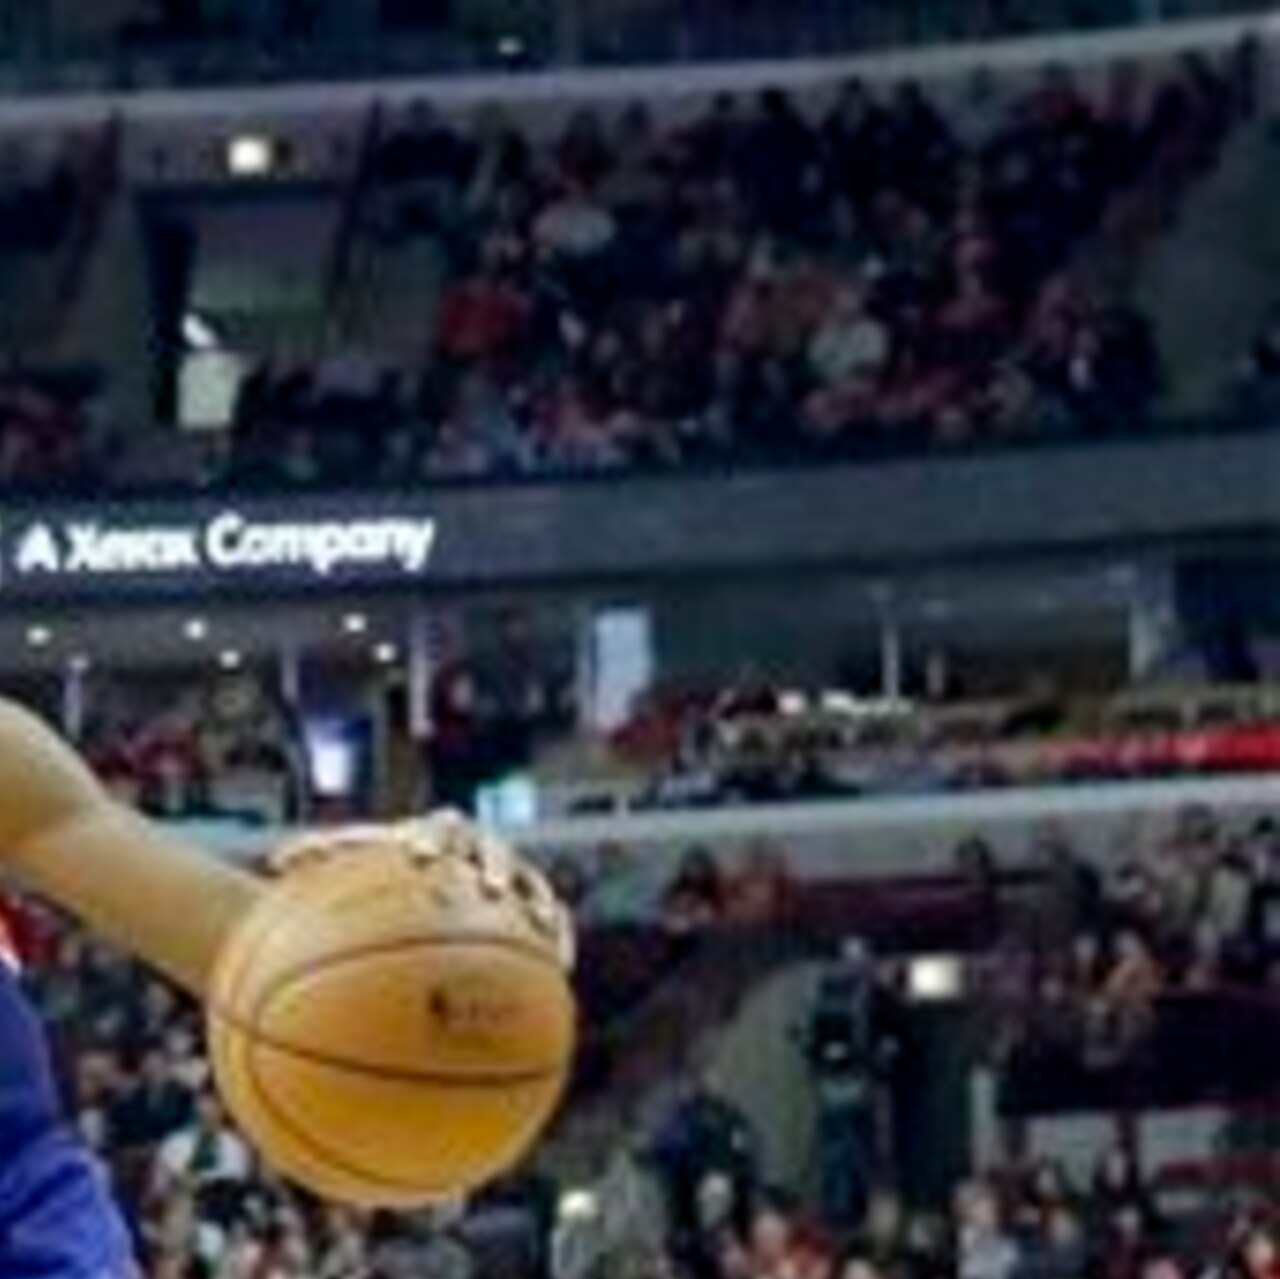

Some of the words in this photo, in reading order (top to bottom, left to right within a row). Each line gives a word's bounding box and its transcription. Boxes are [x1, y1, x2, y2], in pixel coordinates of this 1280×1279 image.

[17, 522, 58, 572] A
[67, 524, 201, 572] Xerox
[206, 512, 434, 573] Company
